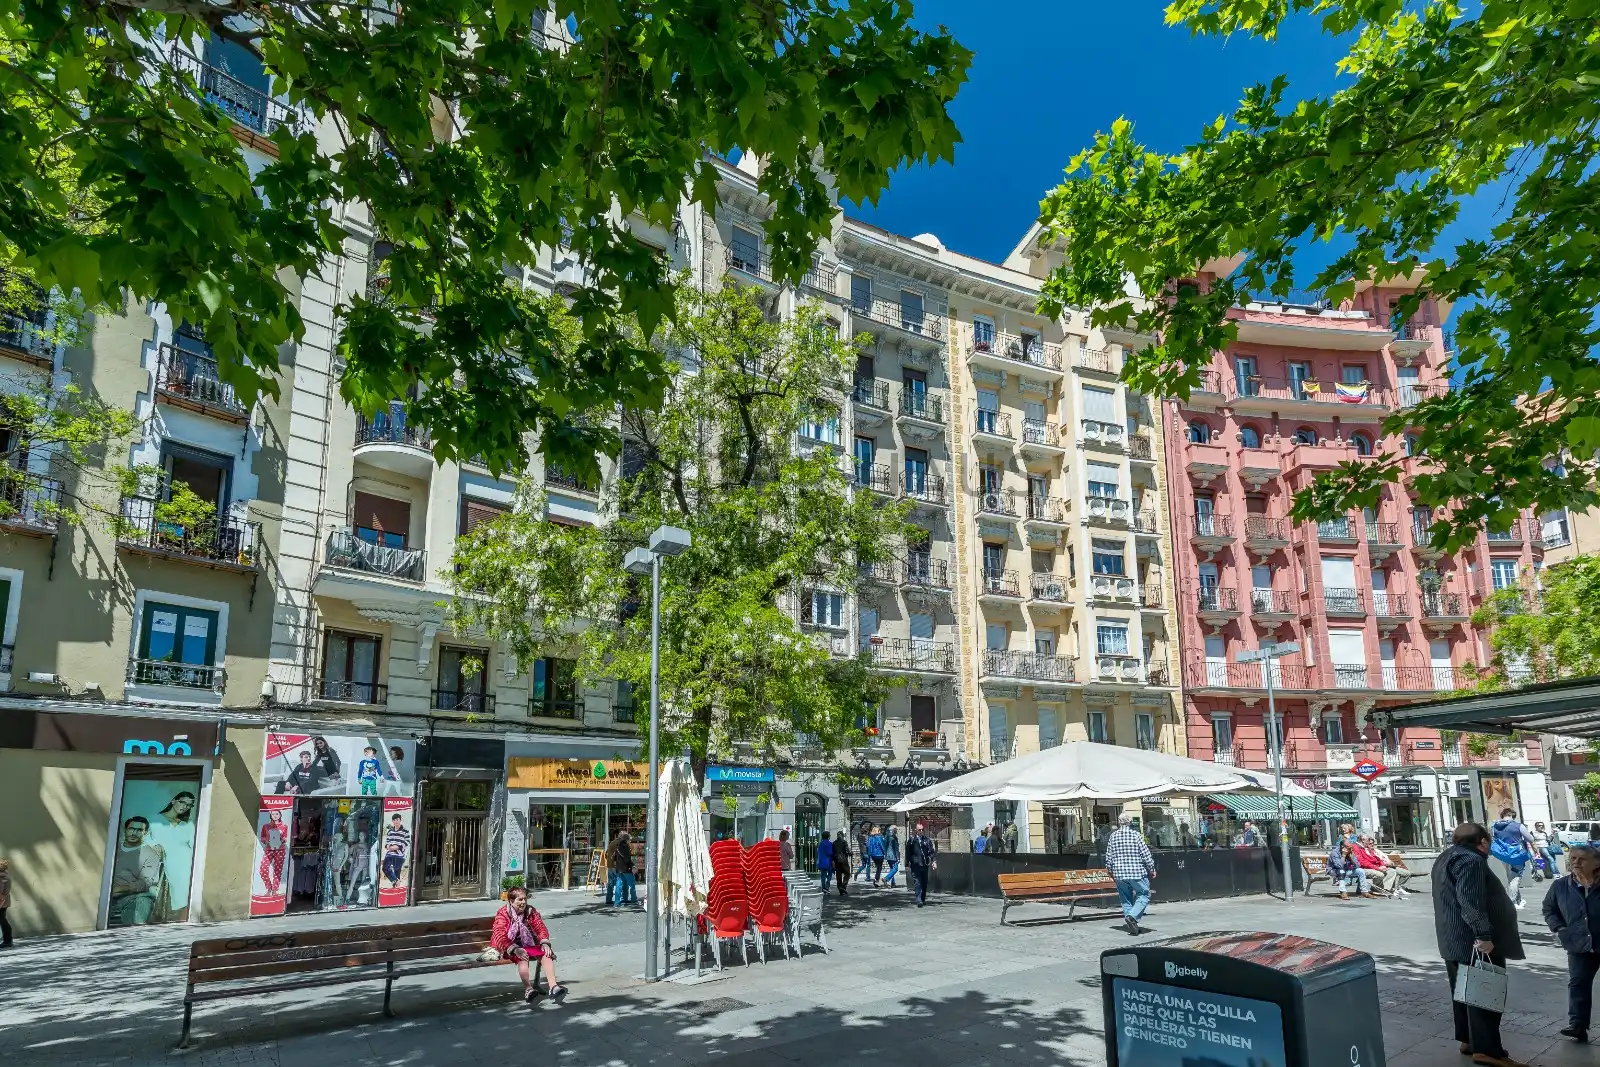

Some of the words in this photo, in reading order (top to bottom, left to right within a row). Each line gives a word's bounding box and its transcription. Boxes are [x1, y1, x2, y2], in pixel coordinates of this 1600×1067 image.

[556, 767, 592, 776] natural
[735, 770, 765, 778] movistar
[1164, 961, 1208, 980] Bigbelly
[1121, 987, 1162, 1005] HASTA
[1165, 995, 1194, 1012] UNA
[1197, 1002, 1257, 1023] COLILLA
[1123, 1000, 1154, 1017] SABE
[1157, 1007, 1185, 1022] QUE
[1188, 1013, 1217, 1029] LAS
[1123, 1013, 1196, 1038] PAPELERAS
[1199, 1028, 1253, 1050] TIENEN
[1124, 1026, 1187, 1049] CENICERO
